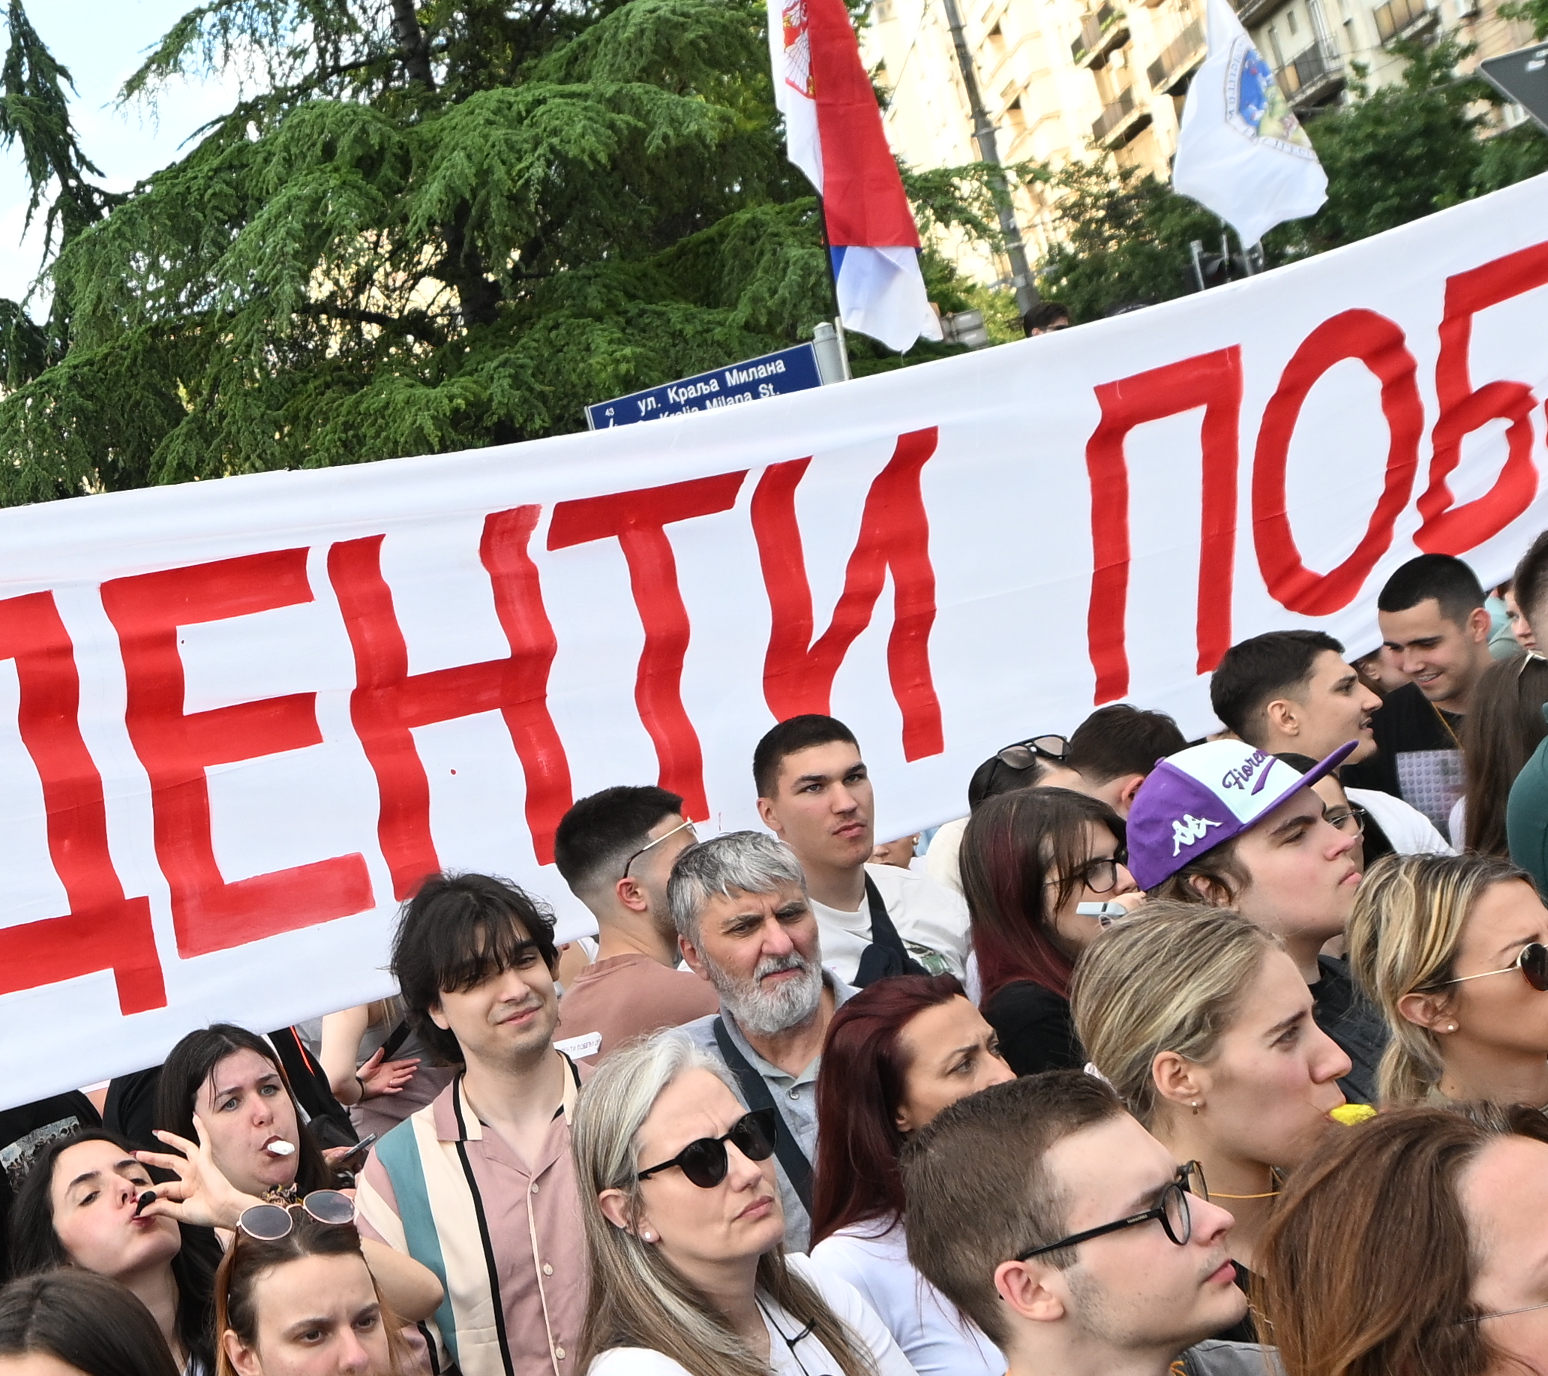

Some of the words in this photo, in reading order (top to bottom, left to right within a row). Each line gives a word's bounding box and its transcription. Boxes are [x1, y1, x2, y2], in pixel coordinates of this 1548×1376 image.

[637, 396, 662, 417] ул.
[667, 376, 721, 406] Краља
[725, 357, 786, 388] Милана
